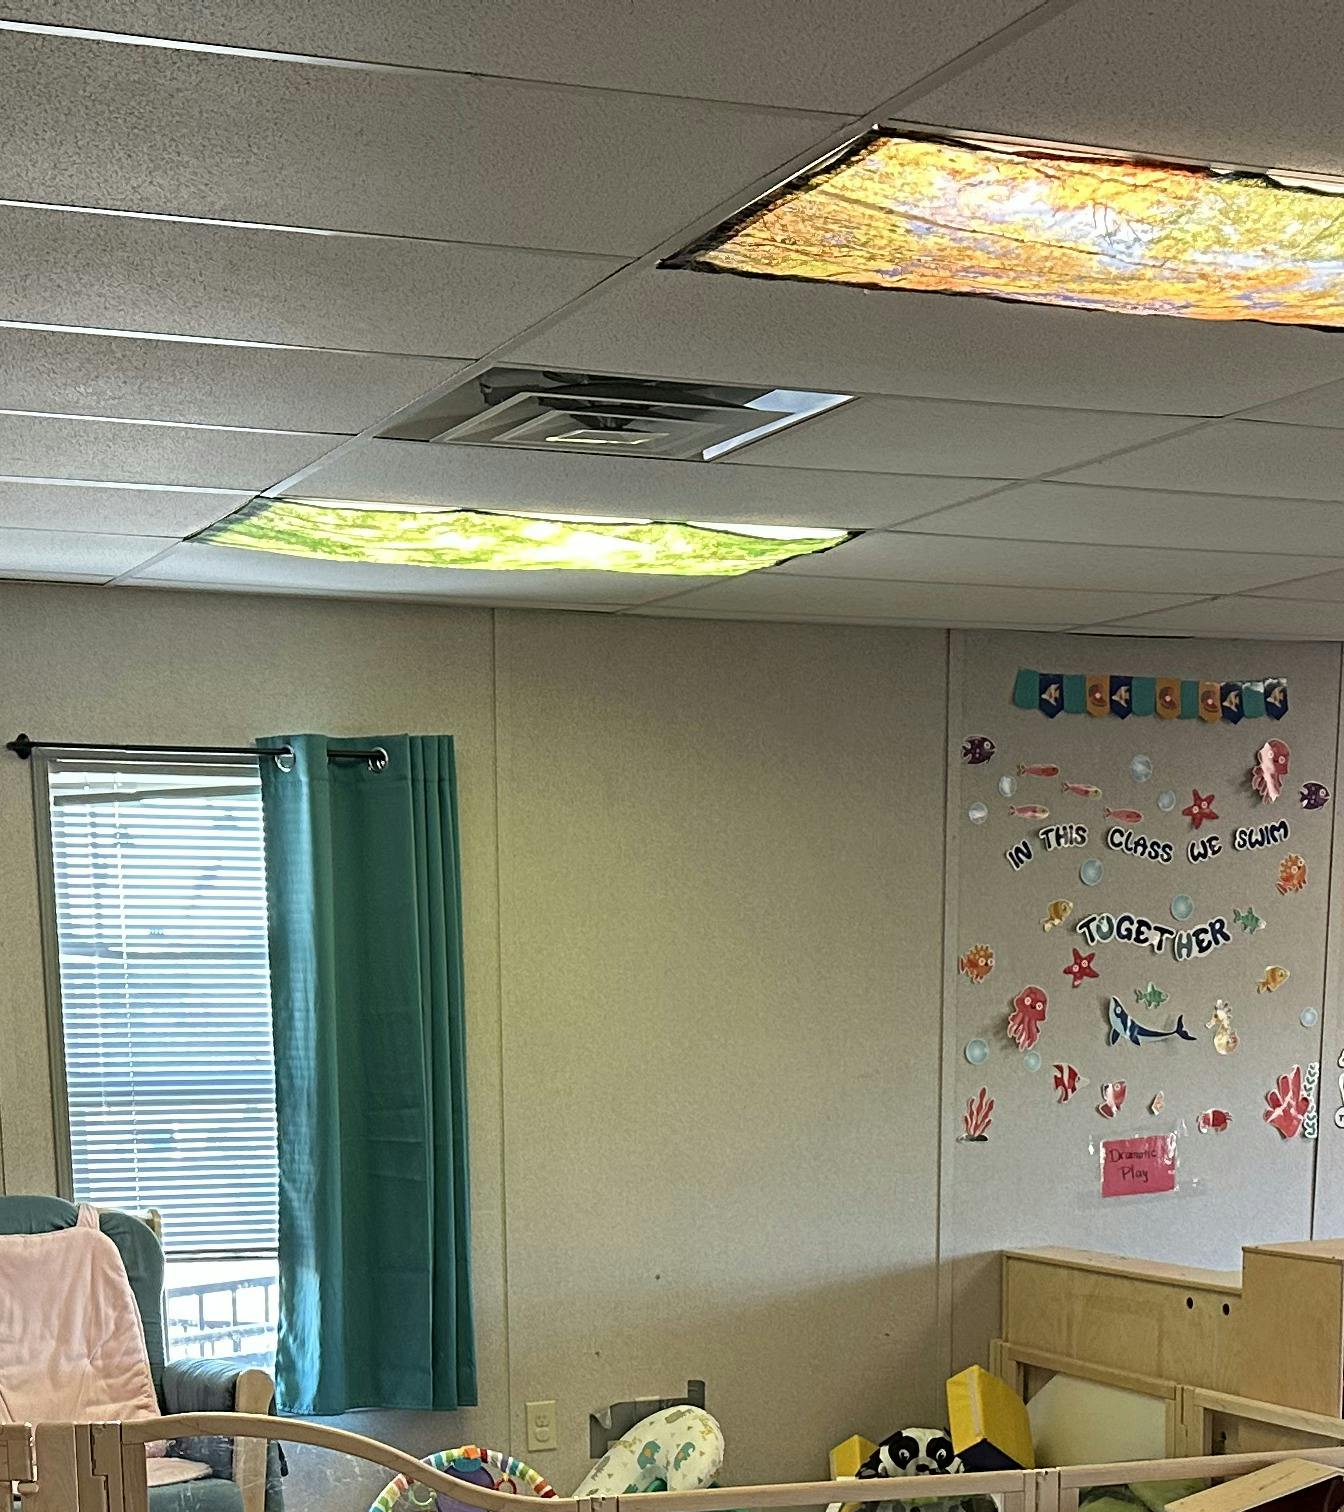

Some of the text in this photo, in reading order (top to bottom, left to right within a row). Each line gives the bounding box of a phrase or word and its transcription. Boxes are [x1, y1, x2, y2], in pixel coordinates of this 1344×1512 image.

[1008, 820, 1289, 869] IN THIS CLASS WE SWIM
[1077, 913, 1232, 961] TOGETHER
[1121, 1164, 1149, 1183] Play
